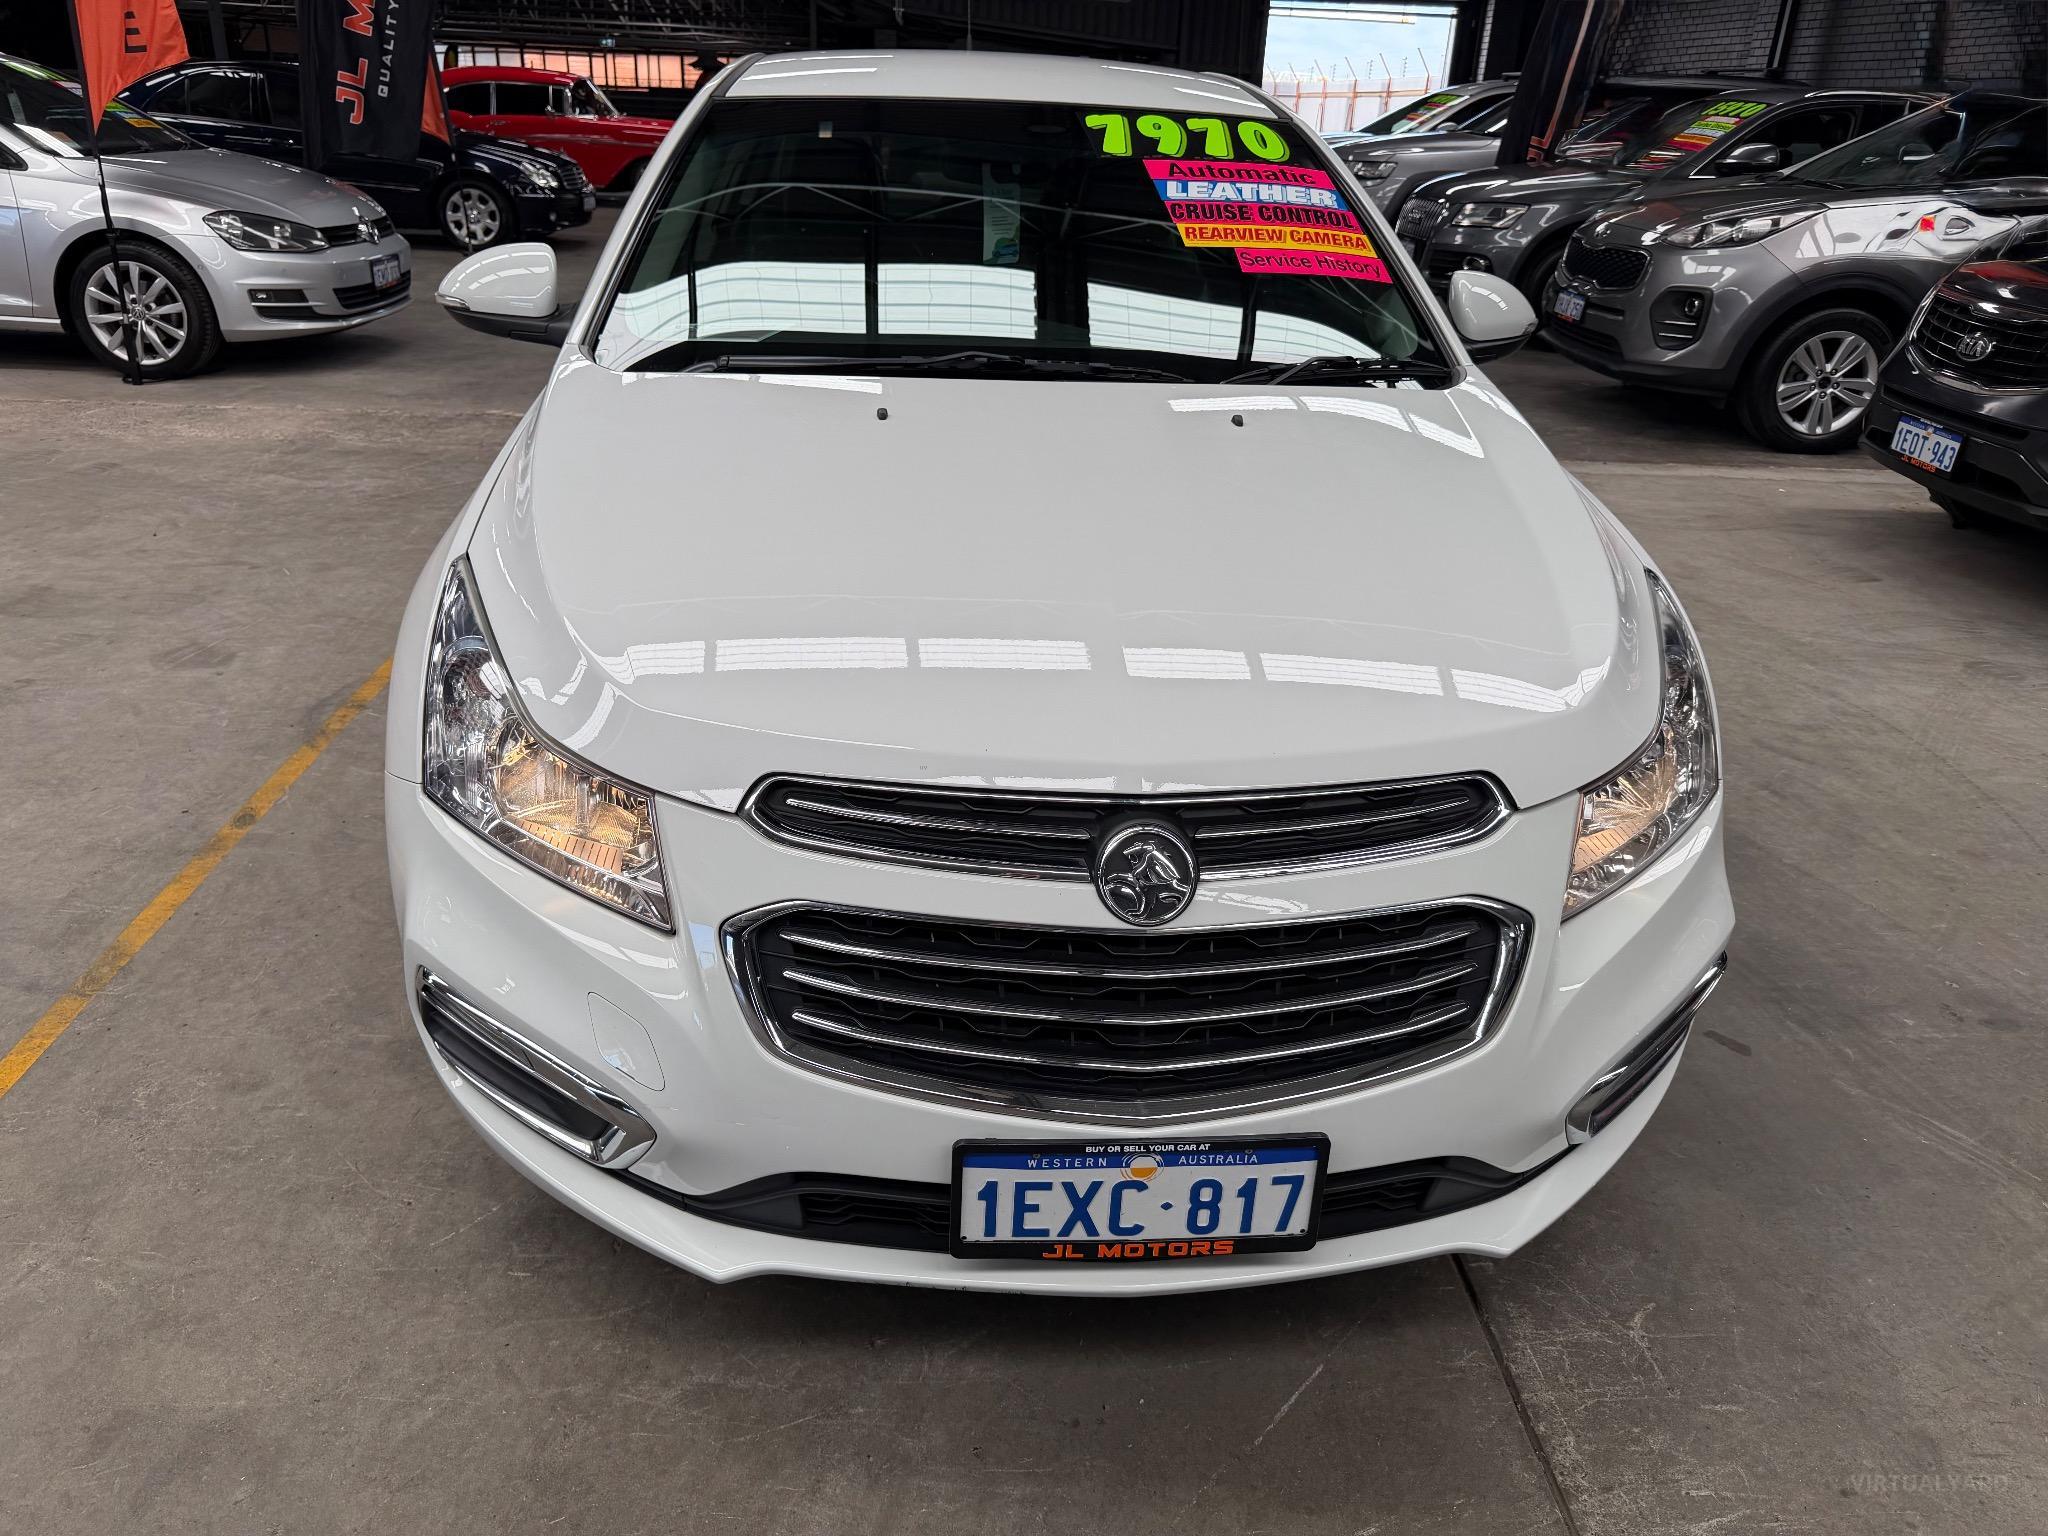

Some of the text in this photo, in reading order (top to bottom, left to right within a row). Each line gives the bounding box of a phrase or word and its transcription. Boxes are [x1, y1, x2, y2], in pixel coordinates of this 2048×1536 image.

[378, 0, 399, 97] QUALITY
[336, 58, 368, 125] JL
[1085, 114, 1290, 162] 7970
[1168, 163, 1316, 185] Automatic
[1166, 180, 1337, 208] LEATHER
[1170, 202, 1356, 229] CRUISE CONTROL
[1184, 226, 1368, 250] REARVIEW CAMERA
[1240, 252, 1381, 278] Service History
[1027, 1154, 1259, 1168] WESTERN AUSTRALIA
[1085, 1145, 1105, 1153] BUY
[1107, 1145, 1120, 1153] OR
[1148, 1144, 1174, 1152] YOUR
[1199, 1143, 1211, 1151] AT
[1042, 1240, 1235, 1258] JL MOTORS
